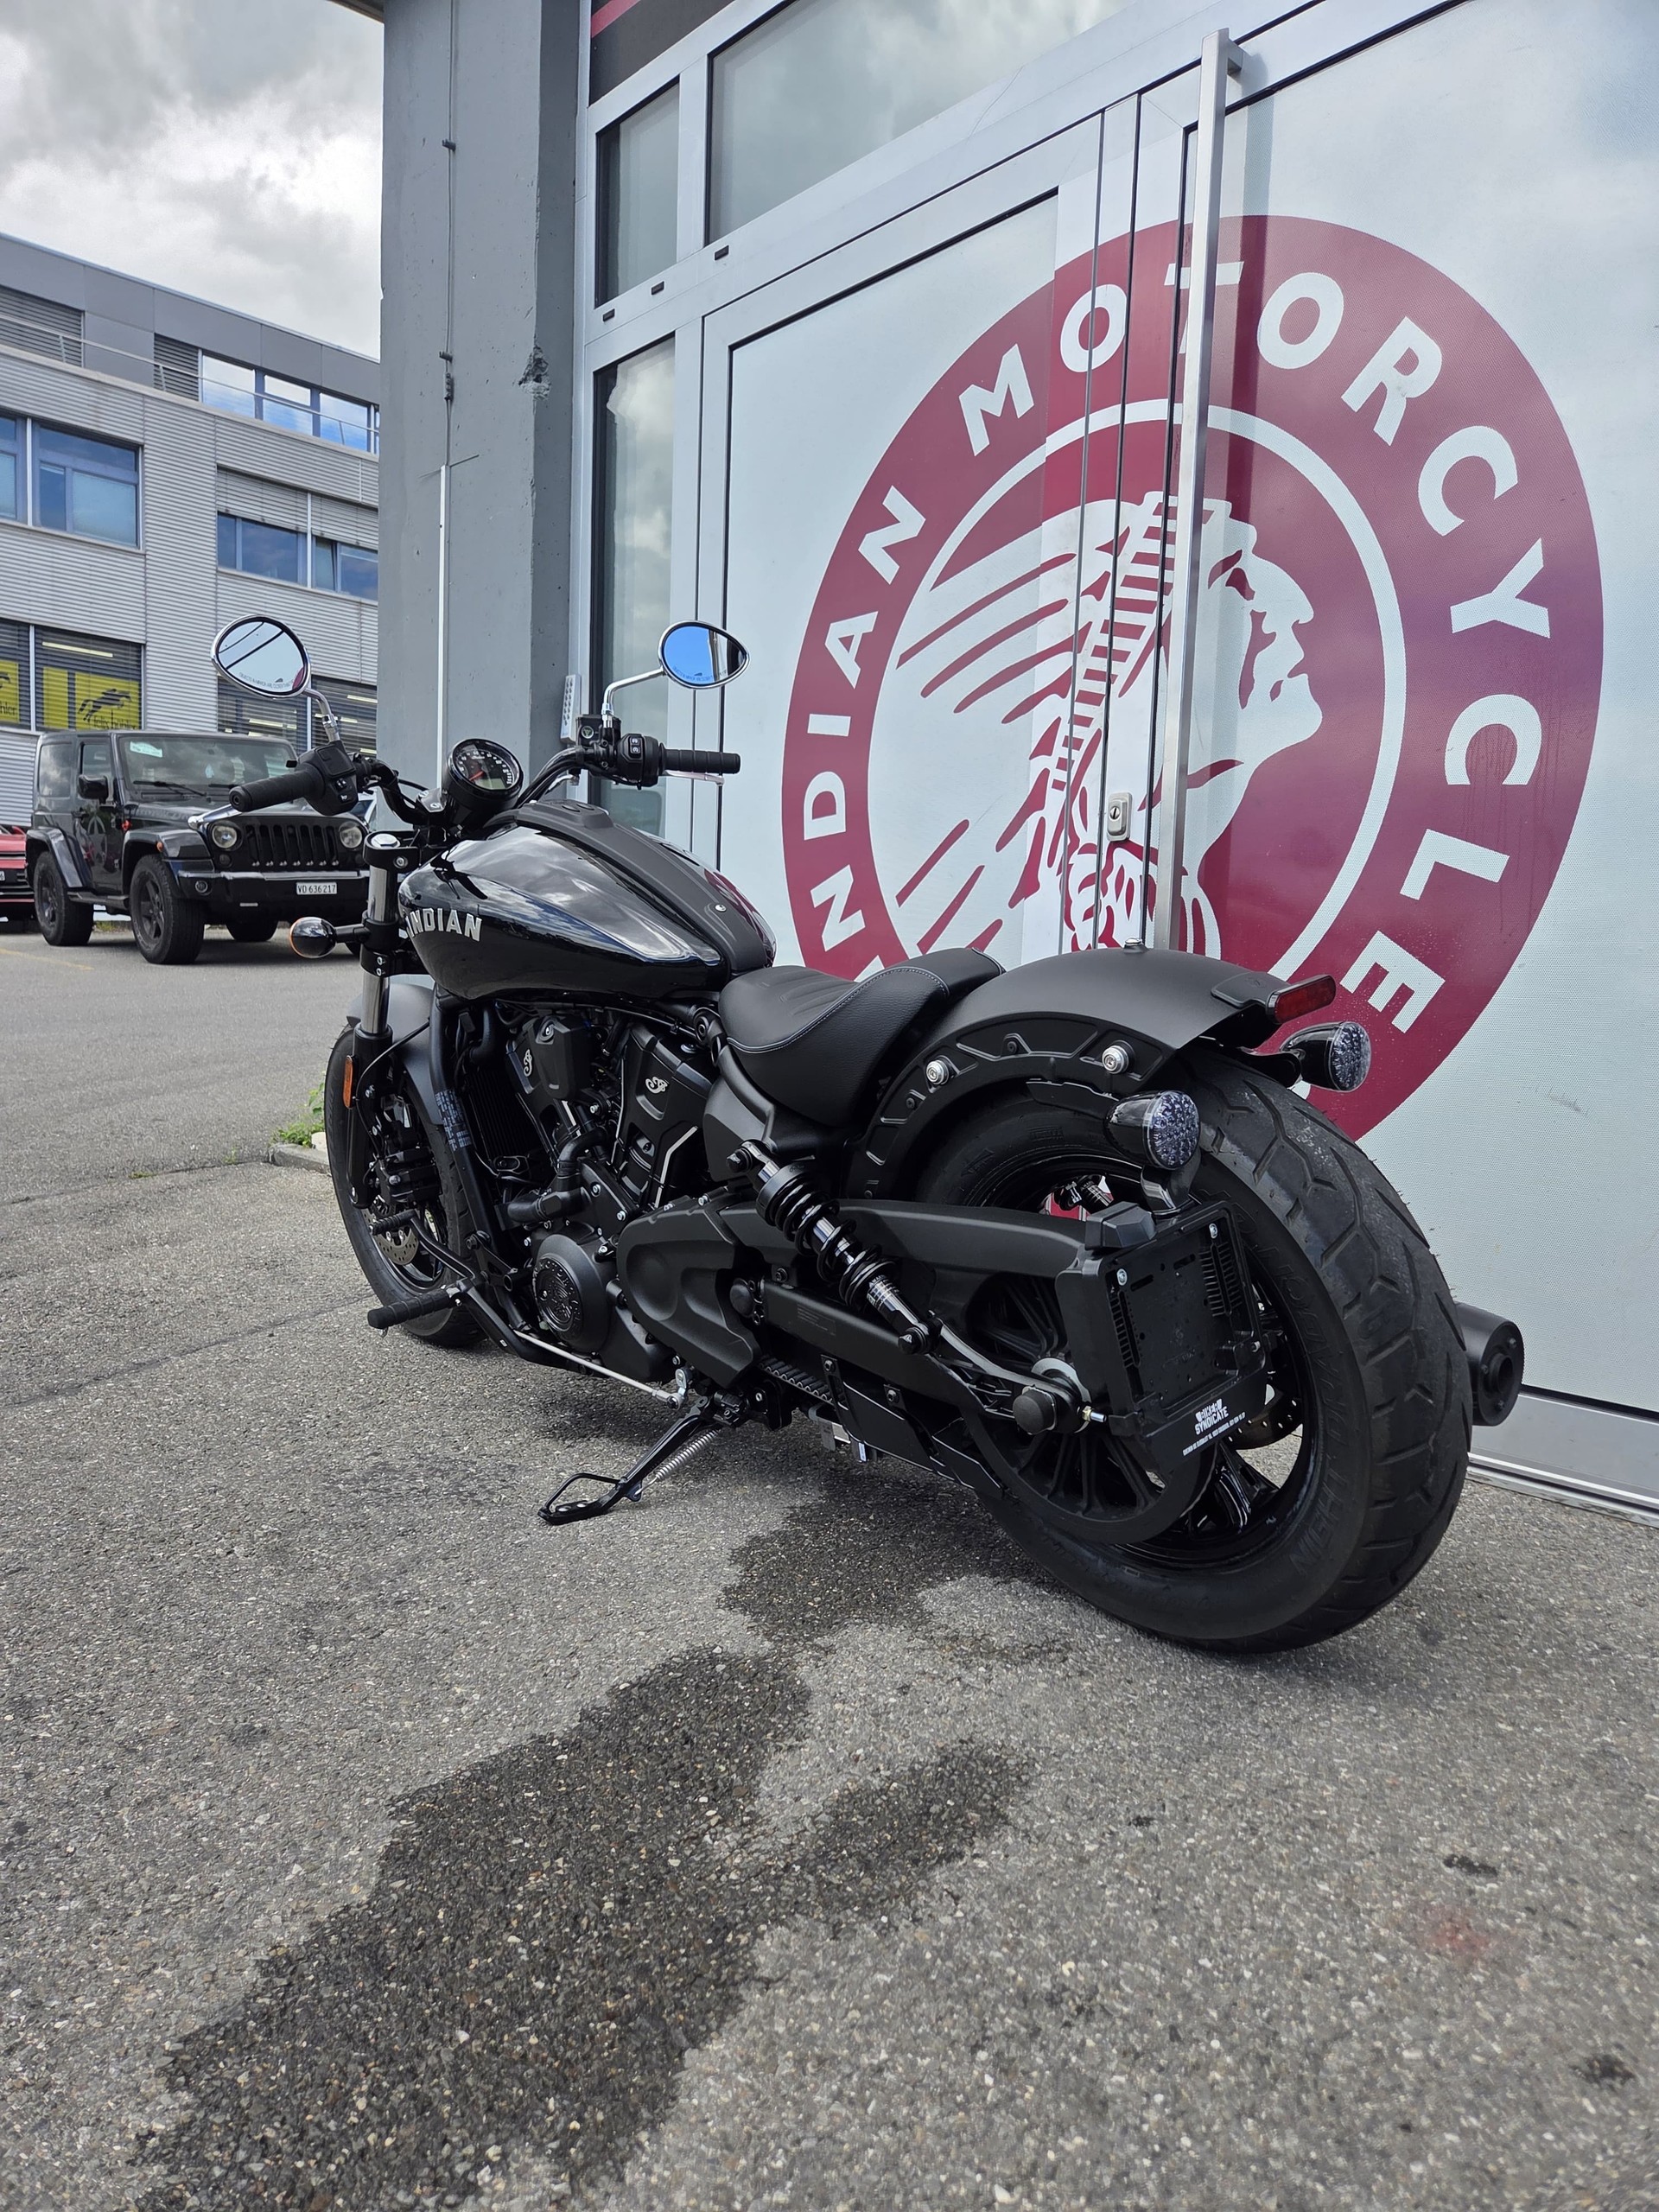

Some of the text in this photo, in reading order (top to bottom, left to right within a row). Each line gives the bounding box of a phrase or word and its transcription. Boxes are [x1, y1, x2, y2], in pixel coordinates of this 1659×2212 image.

[298, 885, 307, 893] VD
[405, 908, 482, 941] INDIAN
[1195, 1406, 1230, 1434] SYNDICATE
